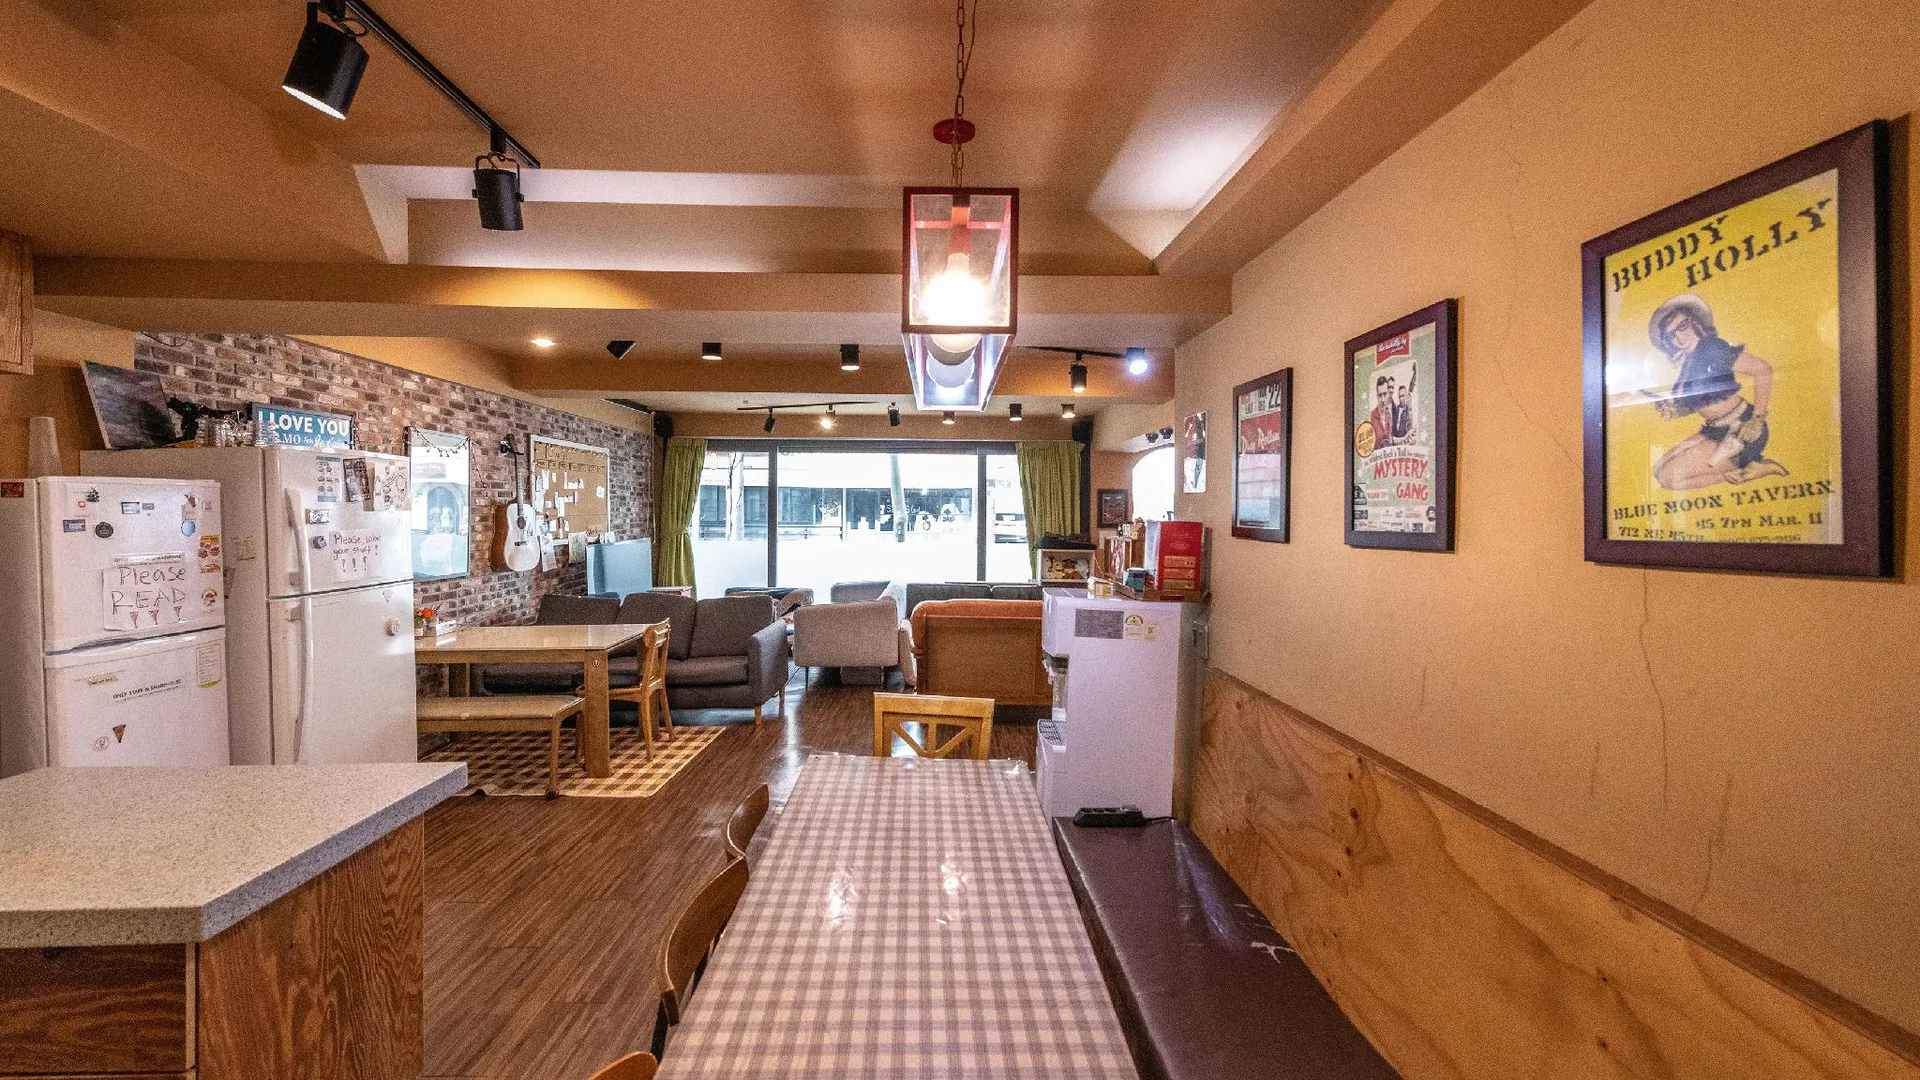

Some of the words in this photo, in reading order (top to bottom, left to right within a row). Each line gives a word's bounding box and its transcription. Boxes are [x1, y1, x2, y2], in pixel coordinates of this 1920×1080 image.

[1612, 214, 1729, 292] BUDDY
[1686, 197, 1832, 287] HOLLY
[269, 412, 313, 433] LOVE
[317, 418, 350, 437] YOU
[1374, 457, 1429, 480] MYSTERY
[1396, 481, 1429, 501] GANG
[1613, 503, 1658, 520] BLUE
[1664, 494, 1723, 514] MOON
[1731, 479, 1835, 504] TAVERN
[118, 566, 186, 586] Please
[111, 587, 186, 615] READ
